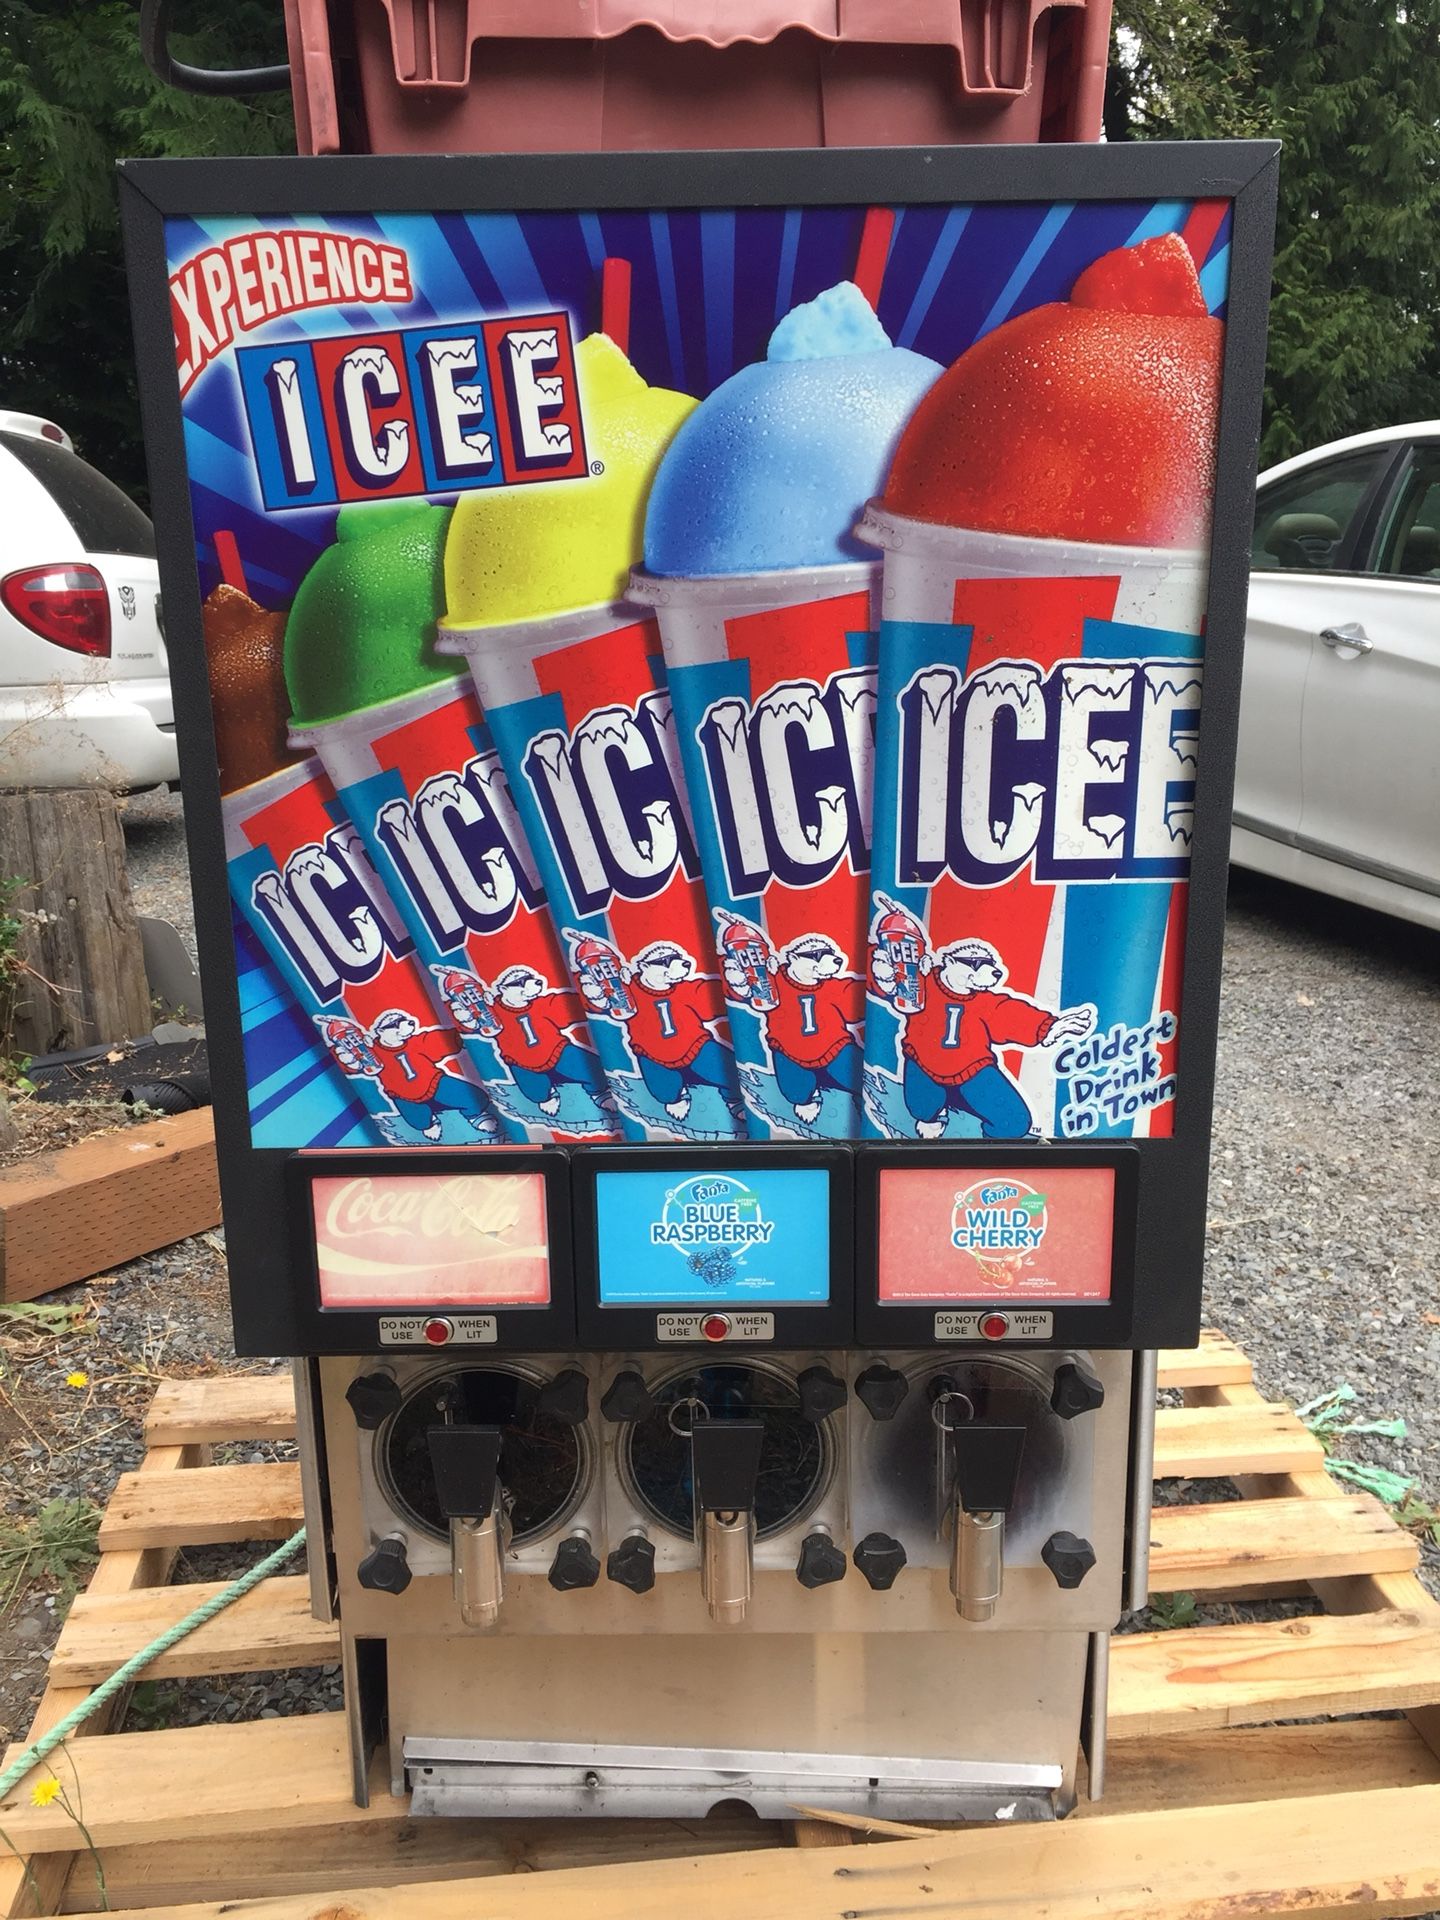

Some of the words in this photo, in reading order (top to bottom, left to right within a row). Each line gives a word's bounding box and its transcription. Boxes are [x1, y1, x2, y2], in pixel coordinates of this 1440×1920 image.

[264, 329, 575, 498] ICEE
[898, 658, 1203, 886] ICEE
[1054, 1016, 1173, 1074] Coldest
[1074, 1051, 1157, 1104] Drink
[1065, 1109, 1094, 1132] in
[1103, 1078, 1176, 1120] Town
[690, 1180, 731, 1202] Fanta
[979, 1184, 1019, 1206] Fanta
[685, 1205, 738, 1223] BLUE
[965, 1209, 1030, 1229] WILD
[652, 1223, 773, 1242] RASPBERRY
[952, 1229, 1044, 1248] CHERRY
[457, 1319, 491, 1329] WHEN
[658, 1317, 676, 1327] DO
[677, 1317, 700, 1326] NOT
[735, 1316, 769, 1326] WHEN
[936, 1316, 954, 1325] DO
[955, 1315, 978, 1325] NOT
[1014, 1315, 1047, 1324] WHEN
[380, 1321, 398, 1331] DO
[399, 1320, 422, 1330] NOT
[946, 1326, 968, 1335] USE
[1021, 1326, 1038, 1335] LIT
[391, 1331, 414, 1341] USE
[466, 1330, 482, 1340] LIT
[668, 1327, 691, 1337] USE
[743, 1327, 760, 1336] LIT
